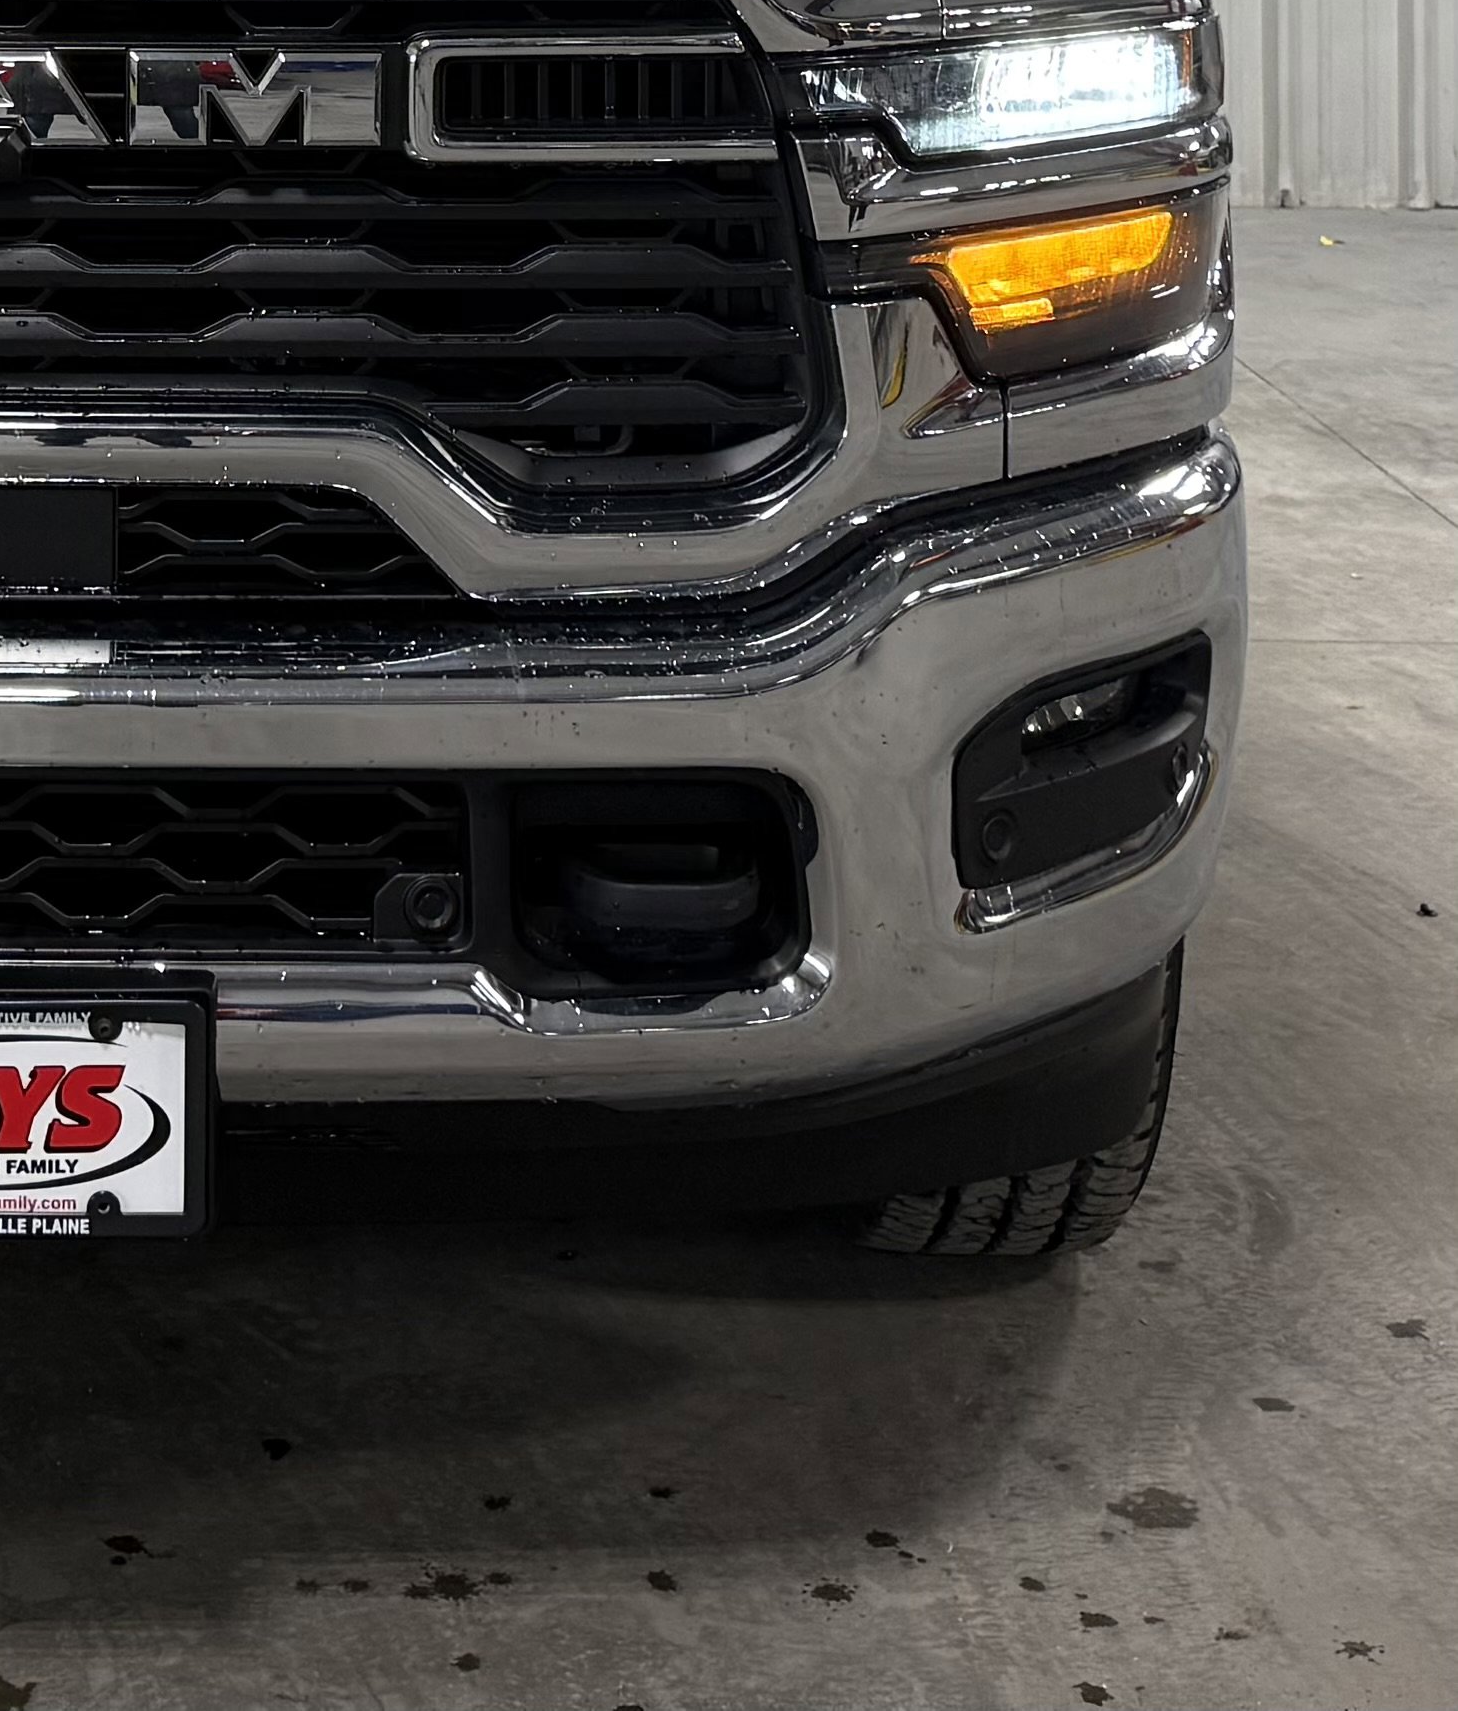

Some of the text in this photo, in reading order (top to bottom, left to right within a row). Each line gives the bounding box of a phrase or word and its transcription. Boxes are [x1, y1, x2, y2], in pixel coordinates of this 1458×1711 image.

[35, 1012, 91, 1025] FAMILY
[6, 1159, 79, 1174] FAMILY
[31, 1218, 90, 1235] PLAINE
